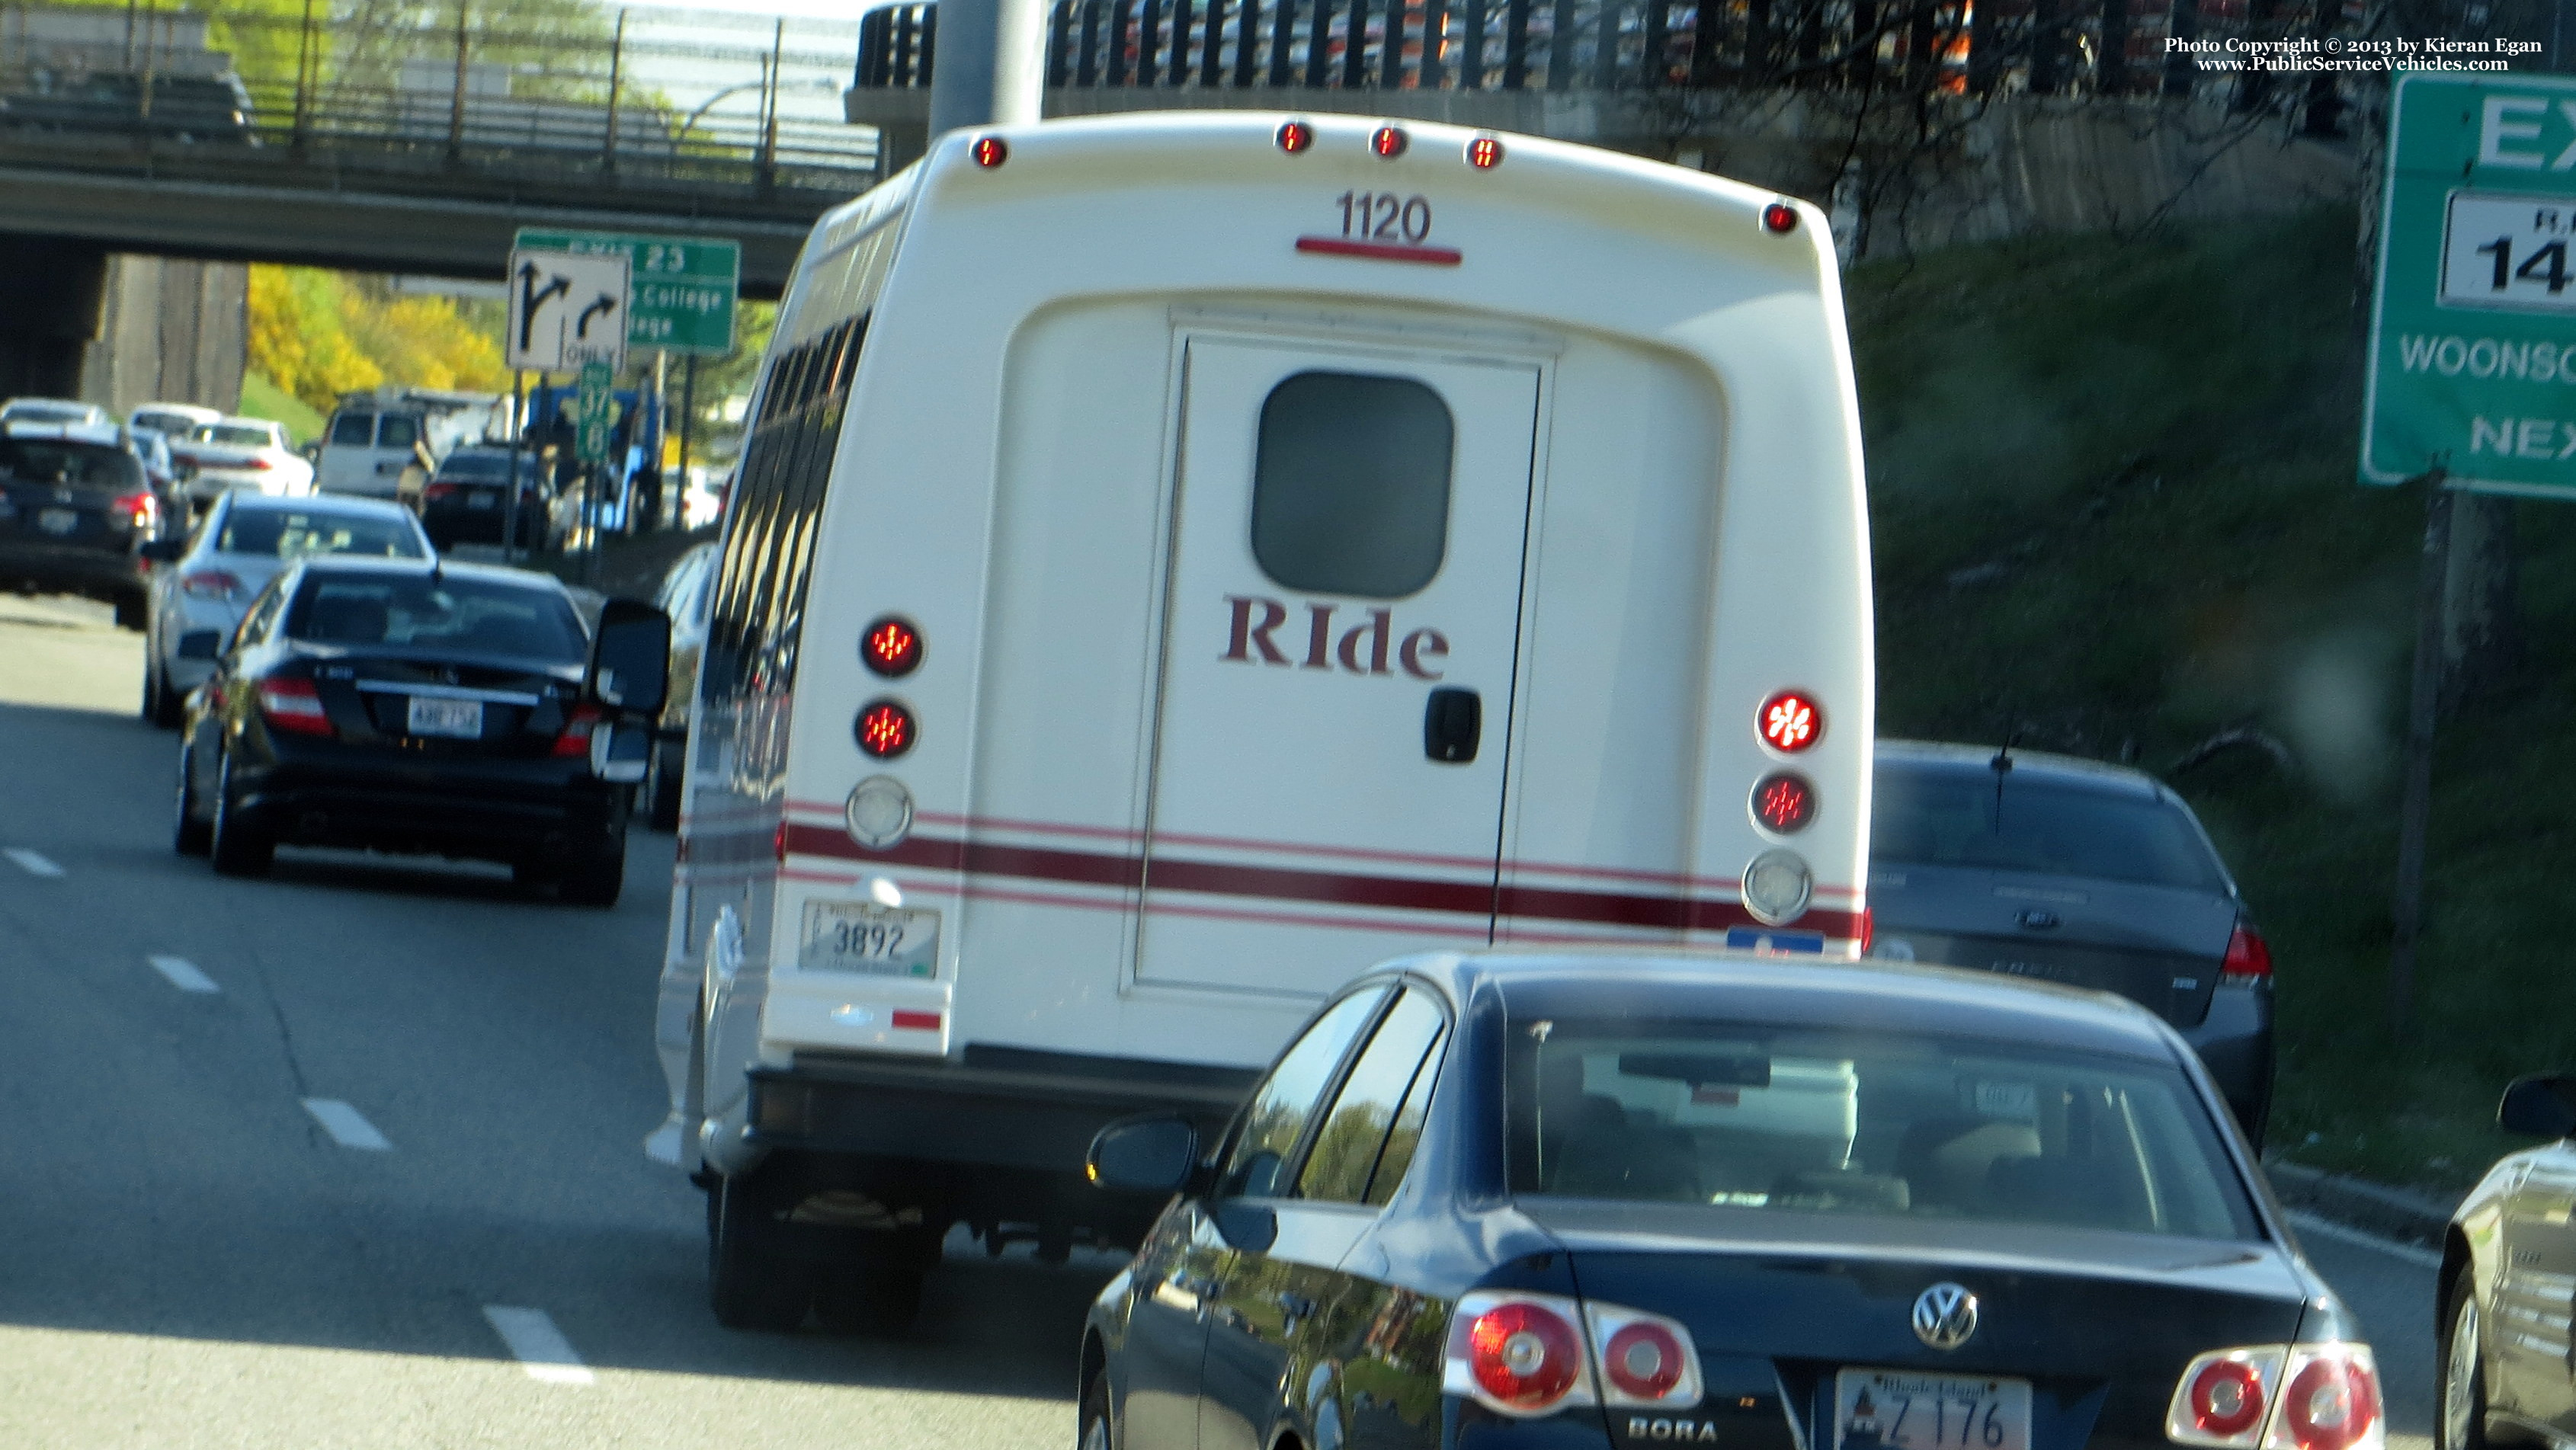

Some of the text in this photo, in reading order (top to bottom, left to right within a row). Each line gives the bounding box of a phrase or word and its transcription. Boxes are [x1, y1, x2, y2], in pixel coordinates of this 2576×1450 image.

[1335, 190, 1432, 243] 1120
[646, 245, 685, 272] 23
[643, 284, 722, 315] College
[1217, 591, 1450, 681] RIde
[832, 919, 905, 959] 3892
[1627, 1416, 1719, 1443] BORA
[1936, 1396, 2003, 1447] 176
